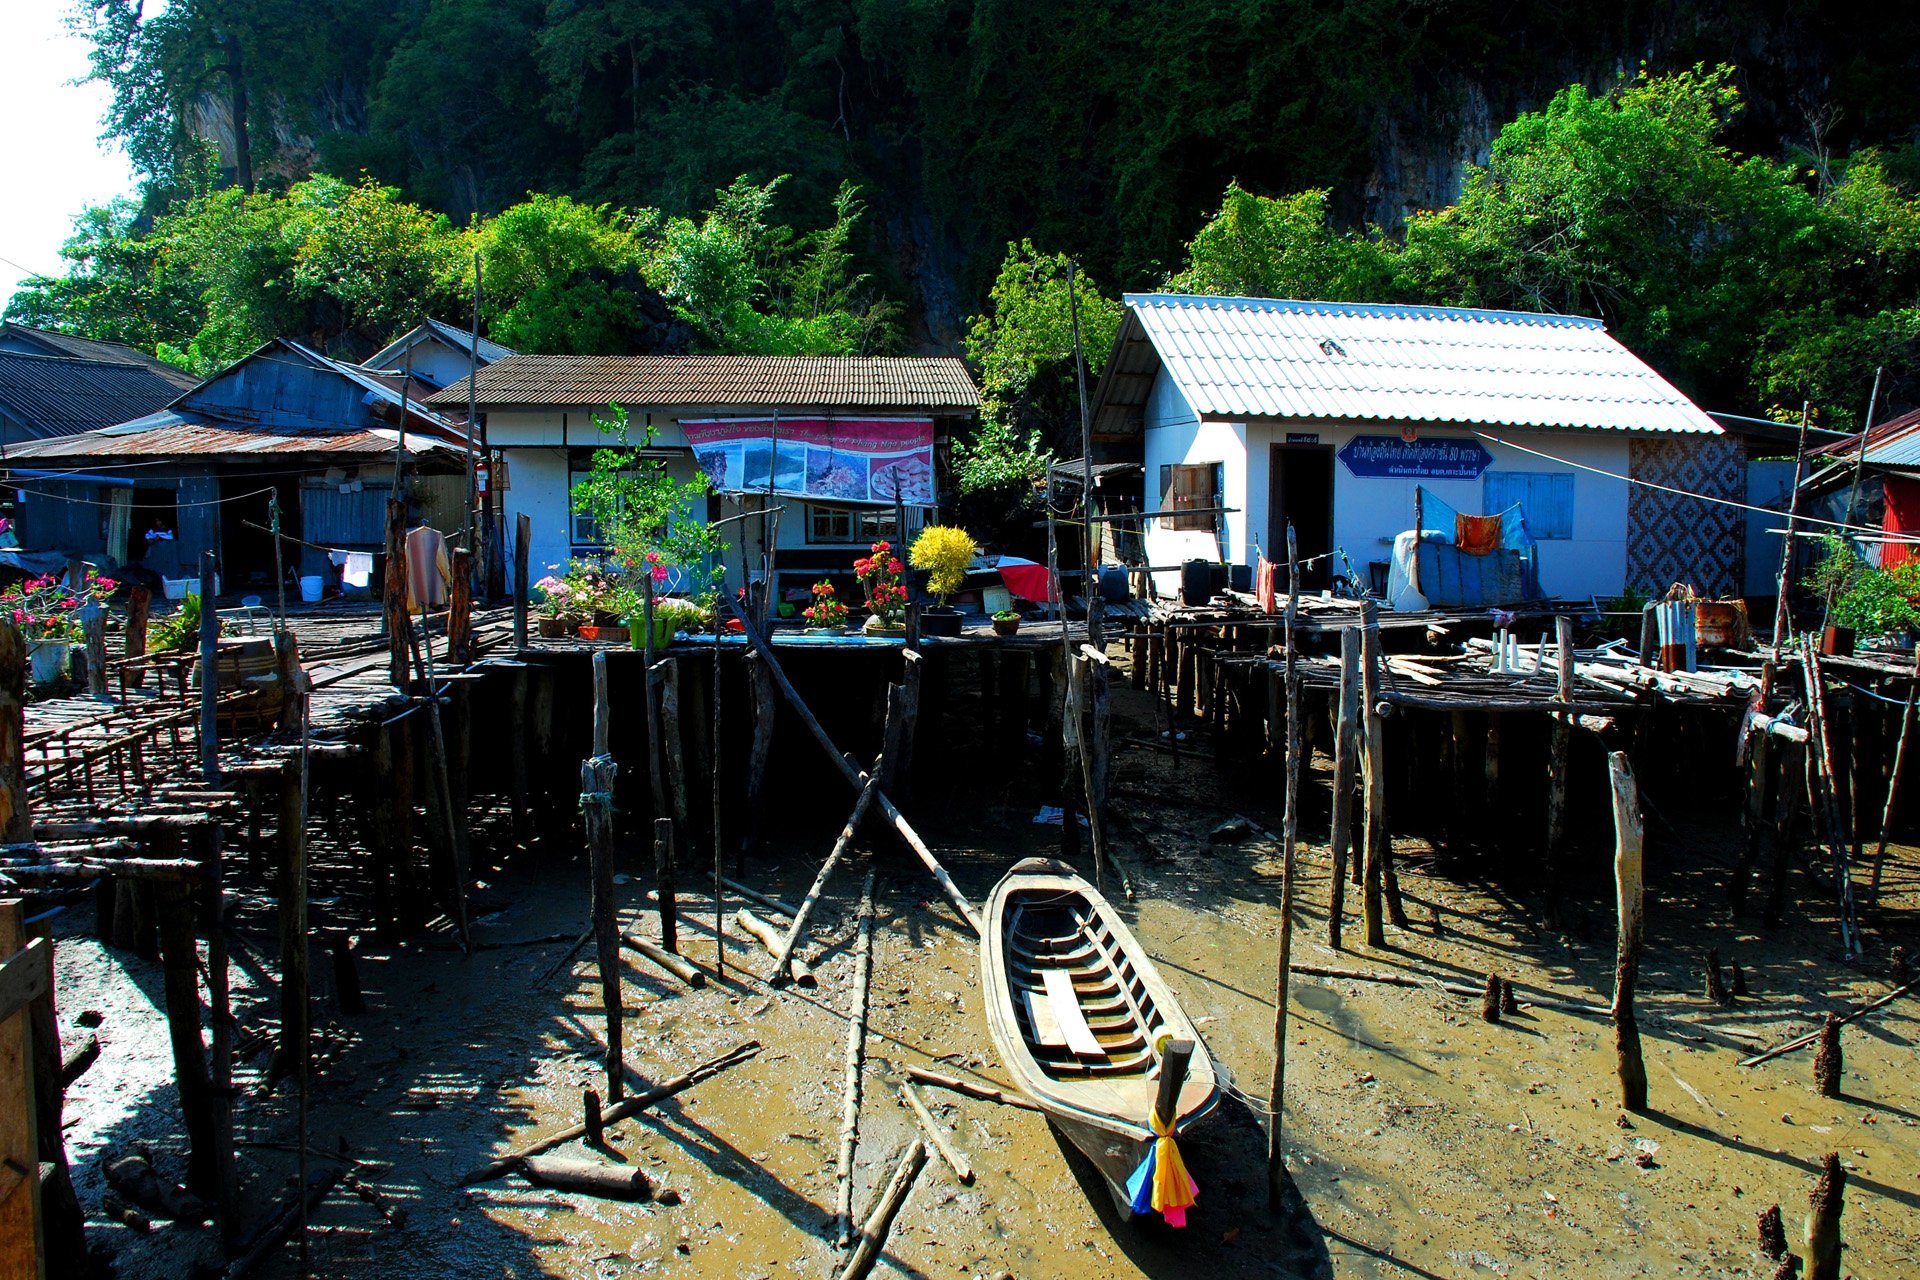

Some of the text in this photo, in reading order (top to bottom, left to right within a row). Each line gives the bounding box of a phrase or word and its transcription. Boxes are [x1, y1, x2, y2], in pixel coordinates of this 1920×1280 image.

[839, 436, 850, 444] of
[851, 438, 878, 449] Phang
[881, 440, 897, 448] Nga
[900, 434, 926, 447] people
[1449, 446, 1459, 461] 80
